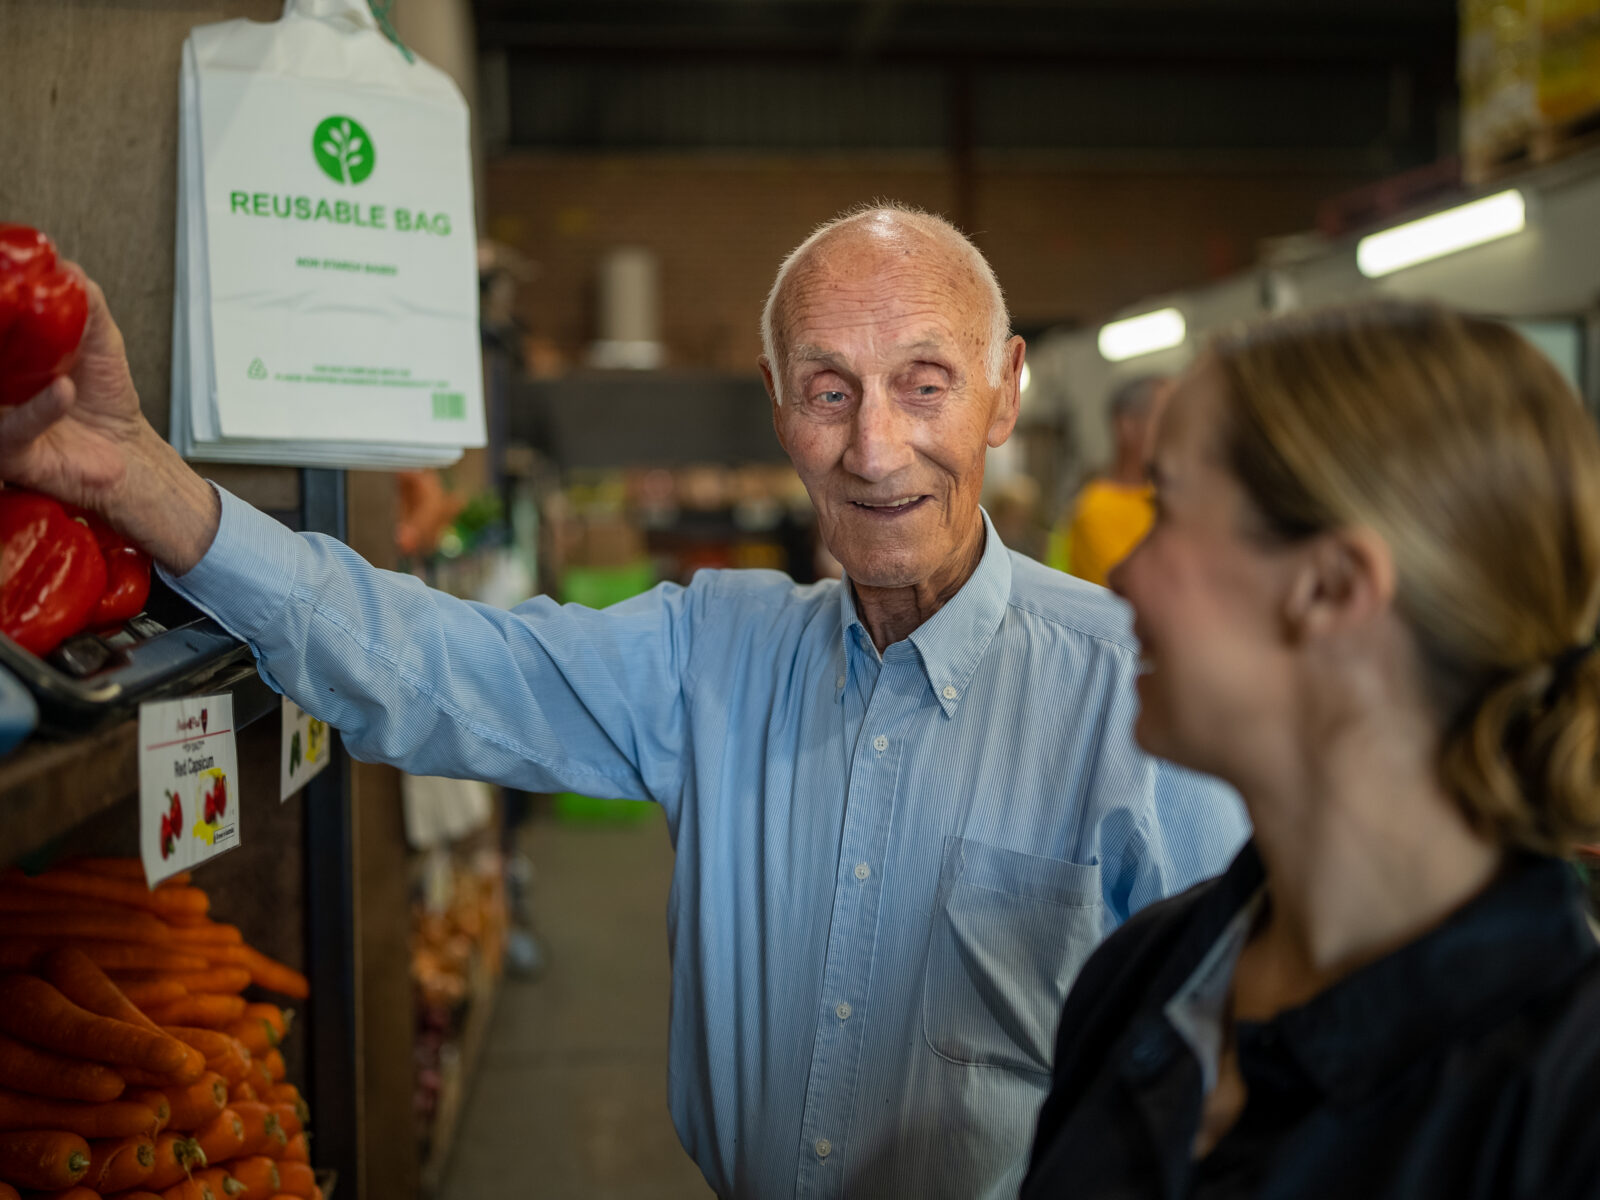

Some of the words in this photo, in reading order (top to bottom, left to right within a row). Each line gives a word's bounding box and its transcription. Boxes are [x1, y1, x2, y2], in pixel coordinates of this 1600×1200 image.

[230, 191, 386, 229] REUSABLE
[394, 208, 452, 236] BAG
[174, 760, 187, 777] Red
[188, 755, 215, 776] Capsicum
